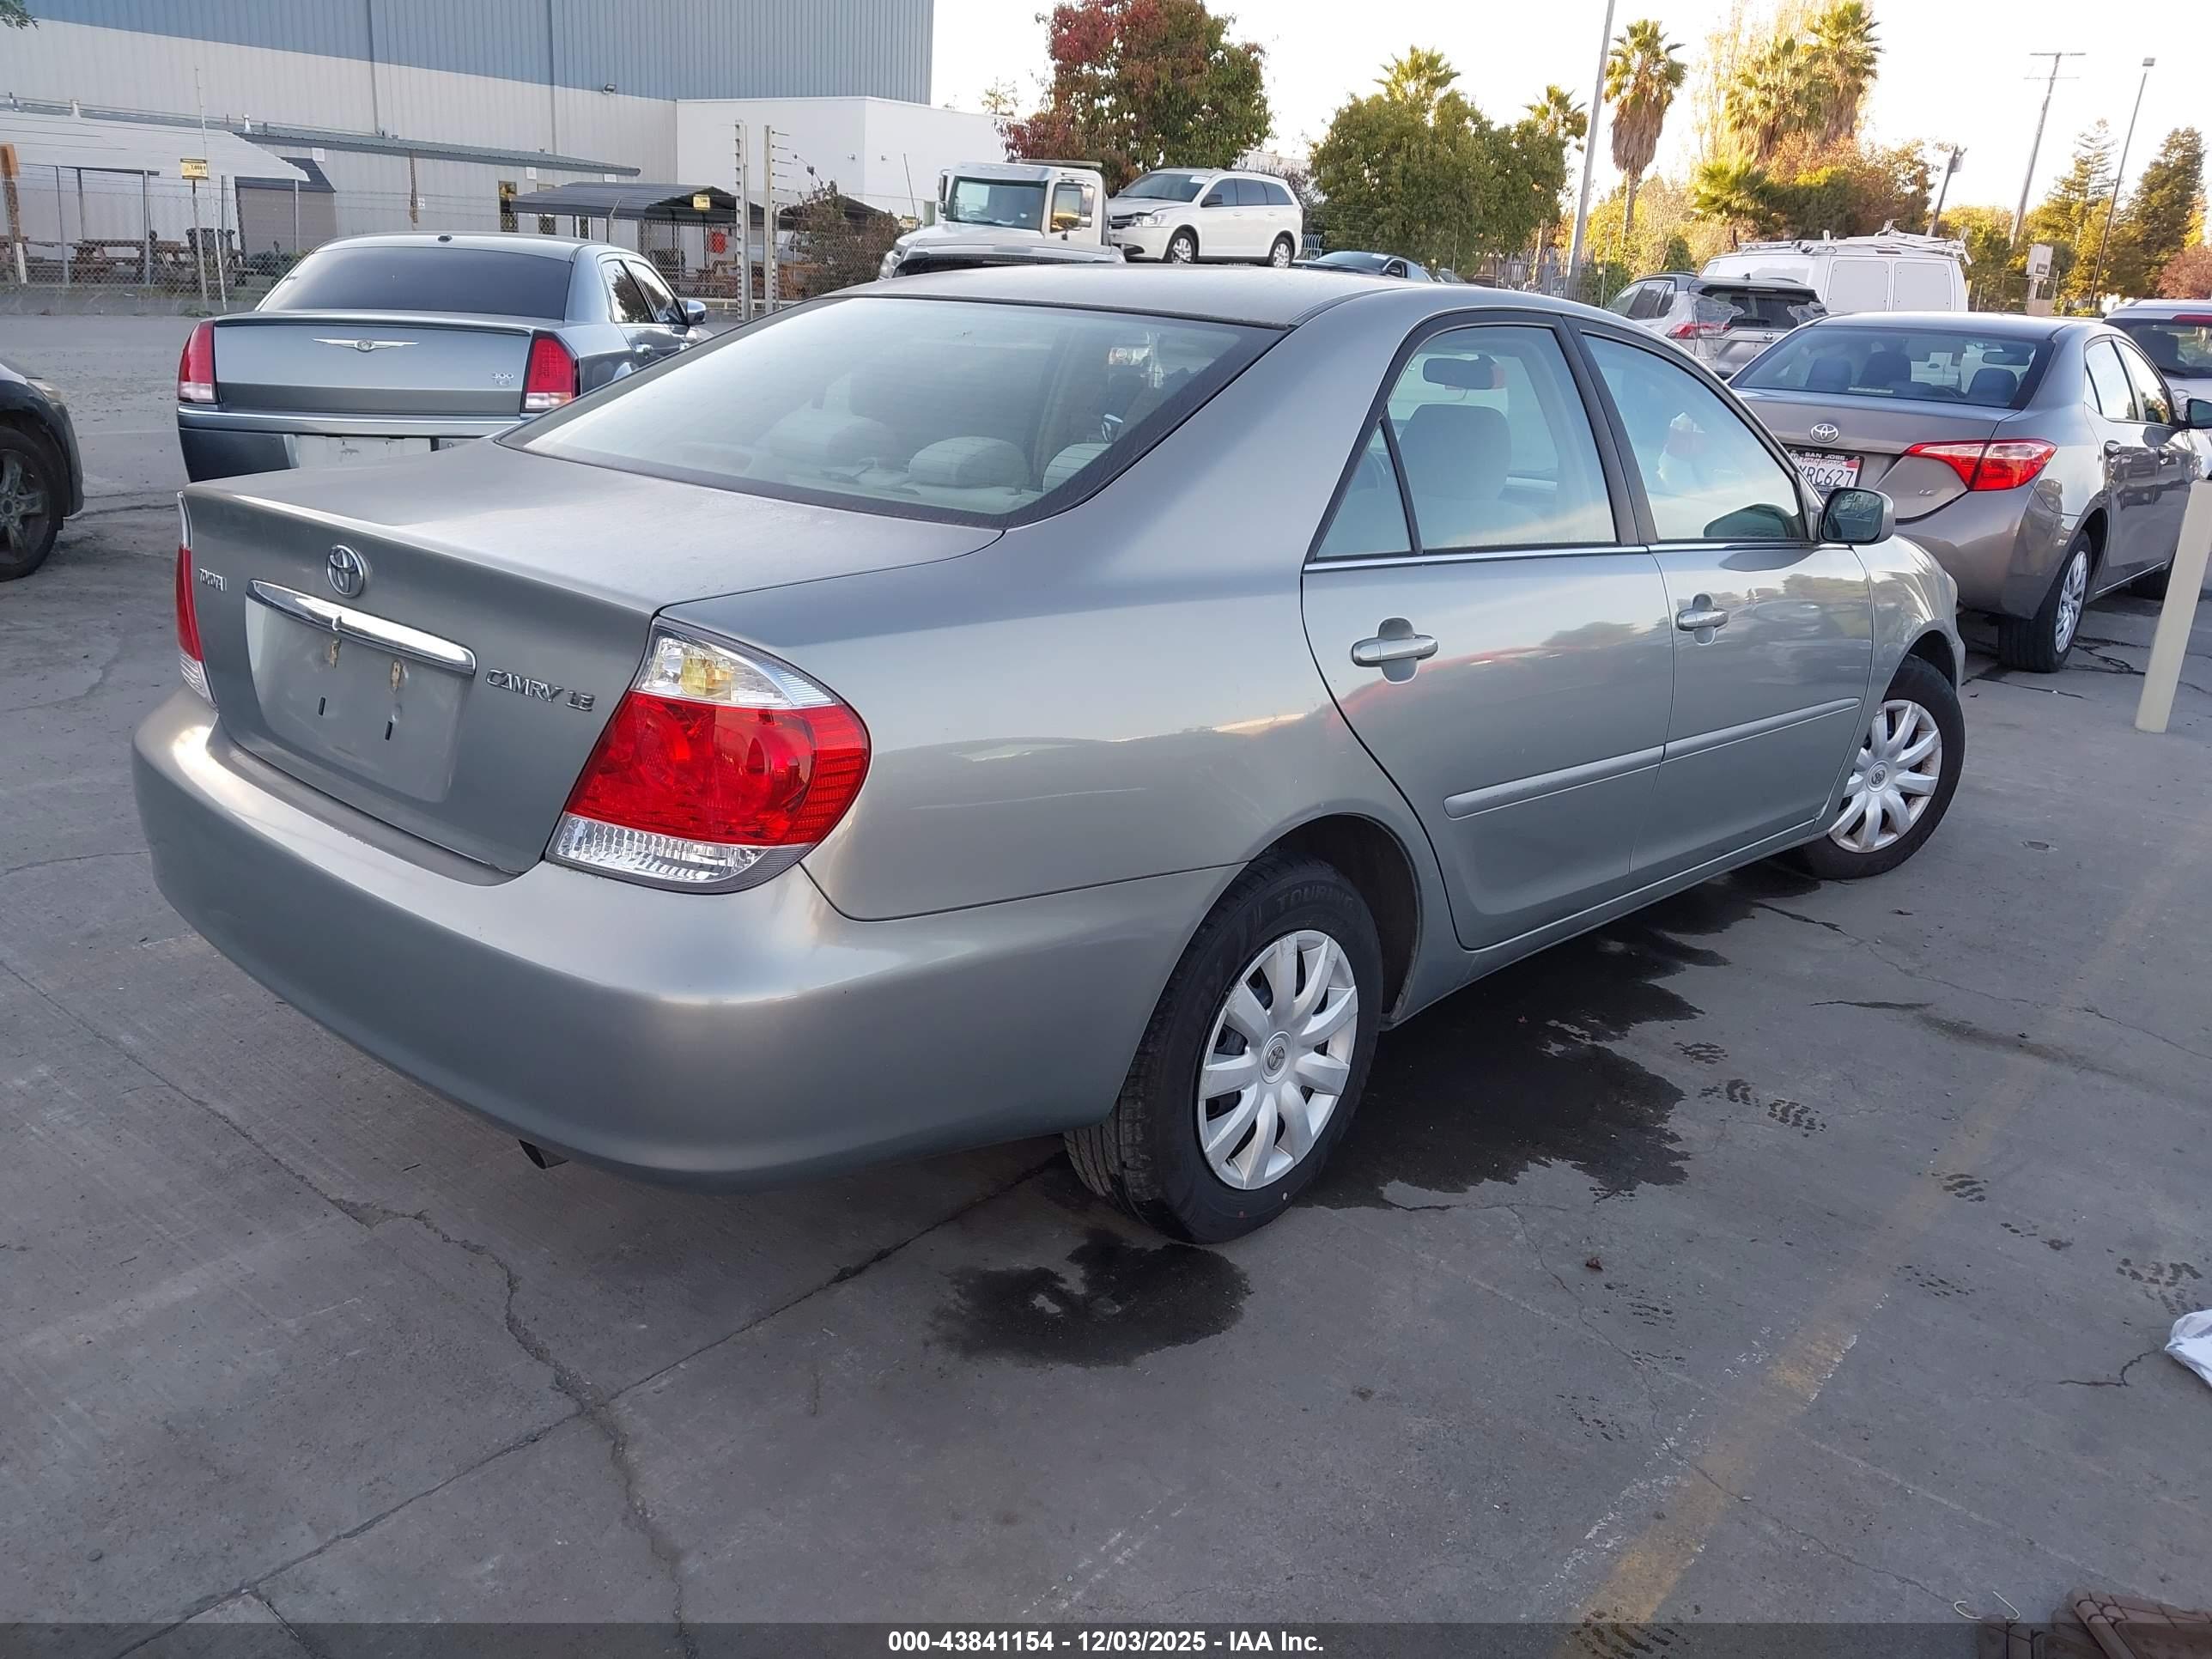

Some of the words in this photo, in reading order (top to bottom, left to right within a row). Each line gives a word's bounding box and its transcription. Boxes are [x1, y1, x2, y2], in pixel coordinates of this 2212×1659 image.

[486, 668, 564, 702] CAMRY
[566, 690, 595, 712] LE
[1277, 884, 1354, 913] TOURING
